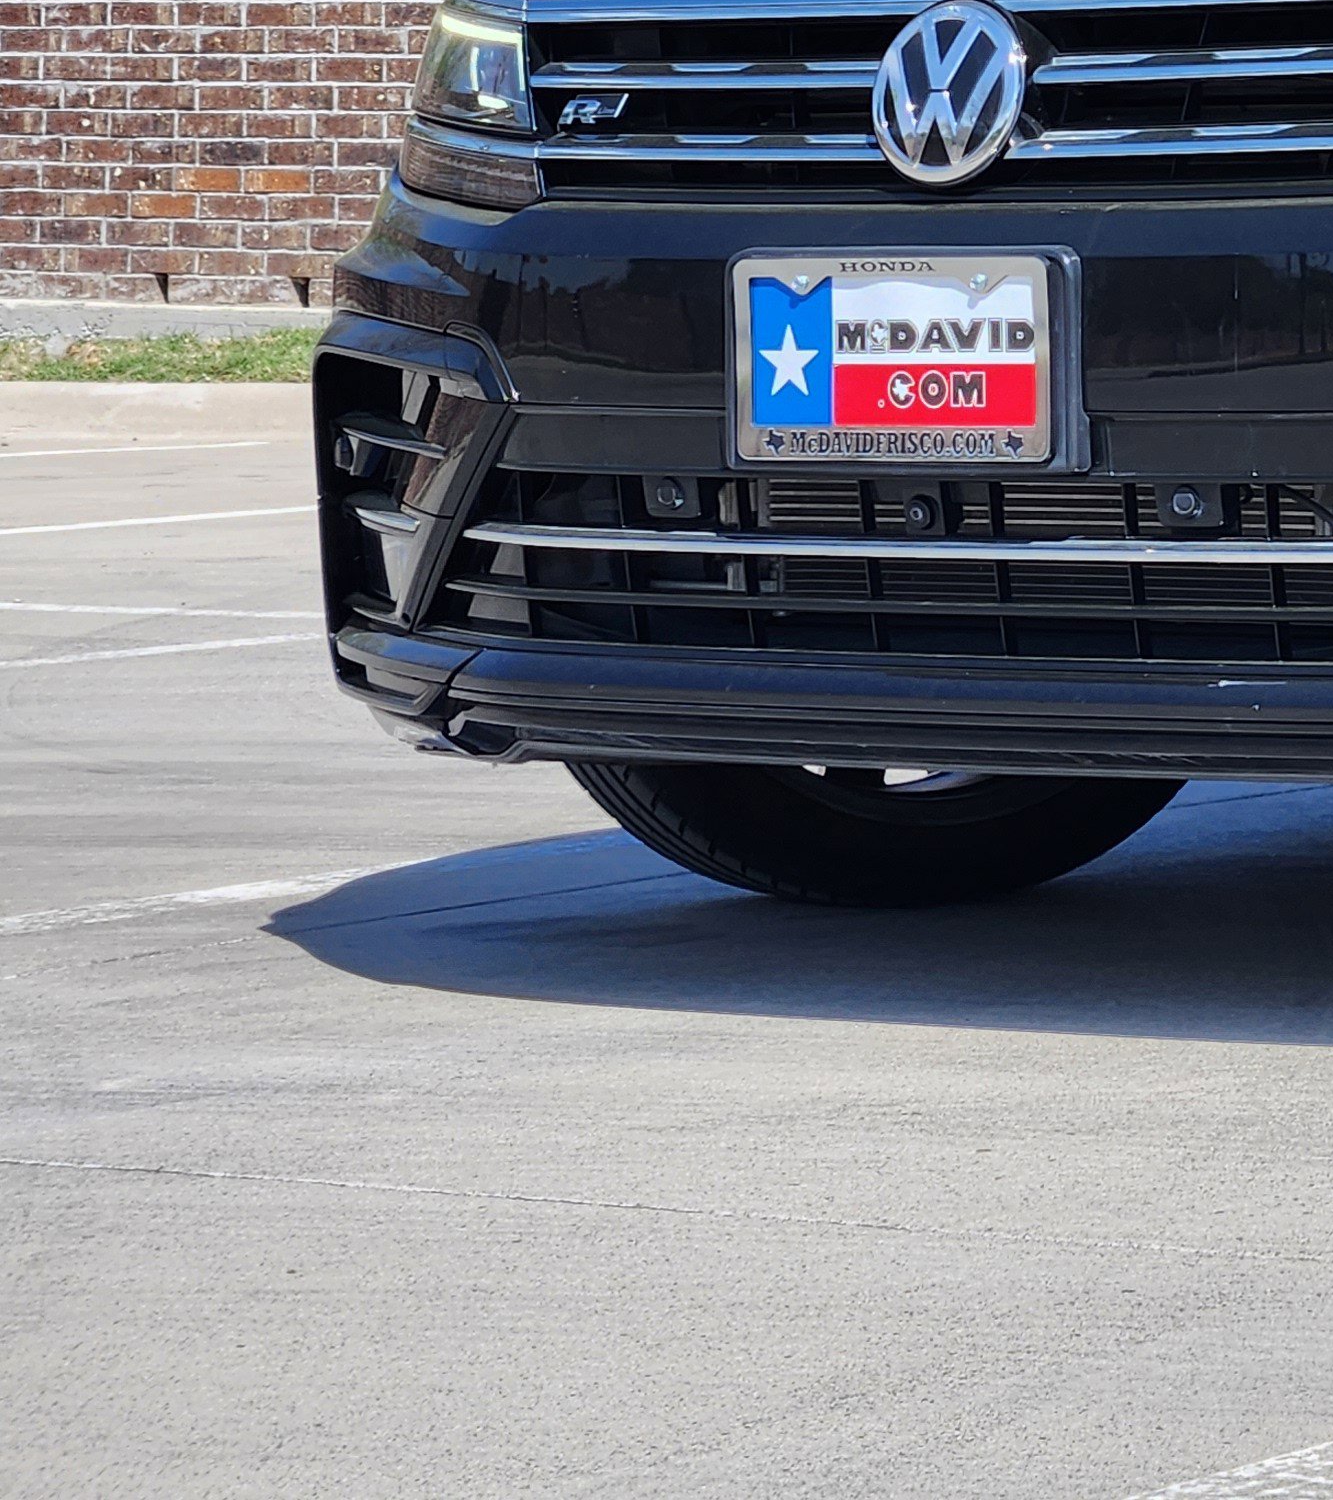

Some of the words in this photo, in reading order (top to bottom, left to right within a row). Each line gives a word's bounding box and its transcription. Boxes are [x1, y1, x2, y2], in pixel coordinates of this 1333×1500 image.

[875, 0, 1023, 178] VW
[840, 261, 935, 273] HONDA
[877, 369, 987, 409] .COM
[789, 430, 997, 457] McDAVIDFRISCO.COM
